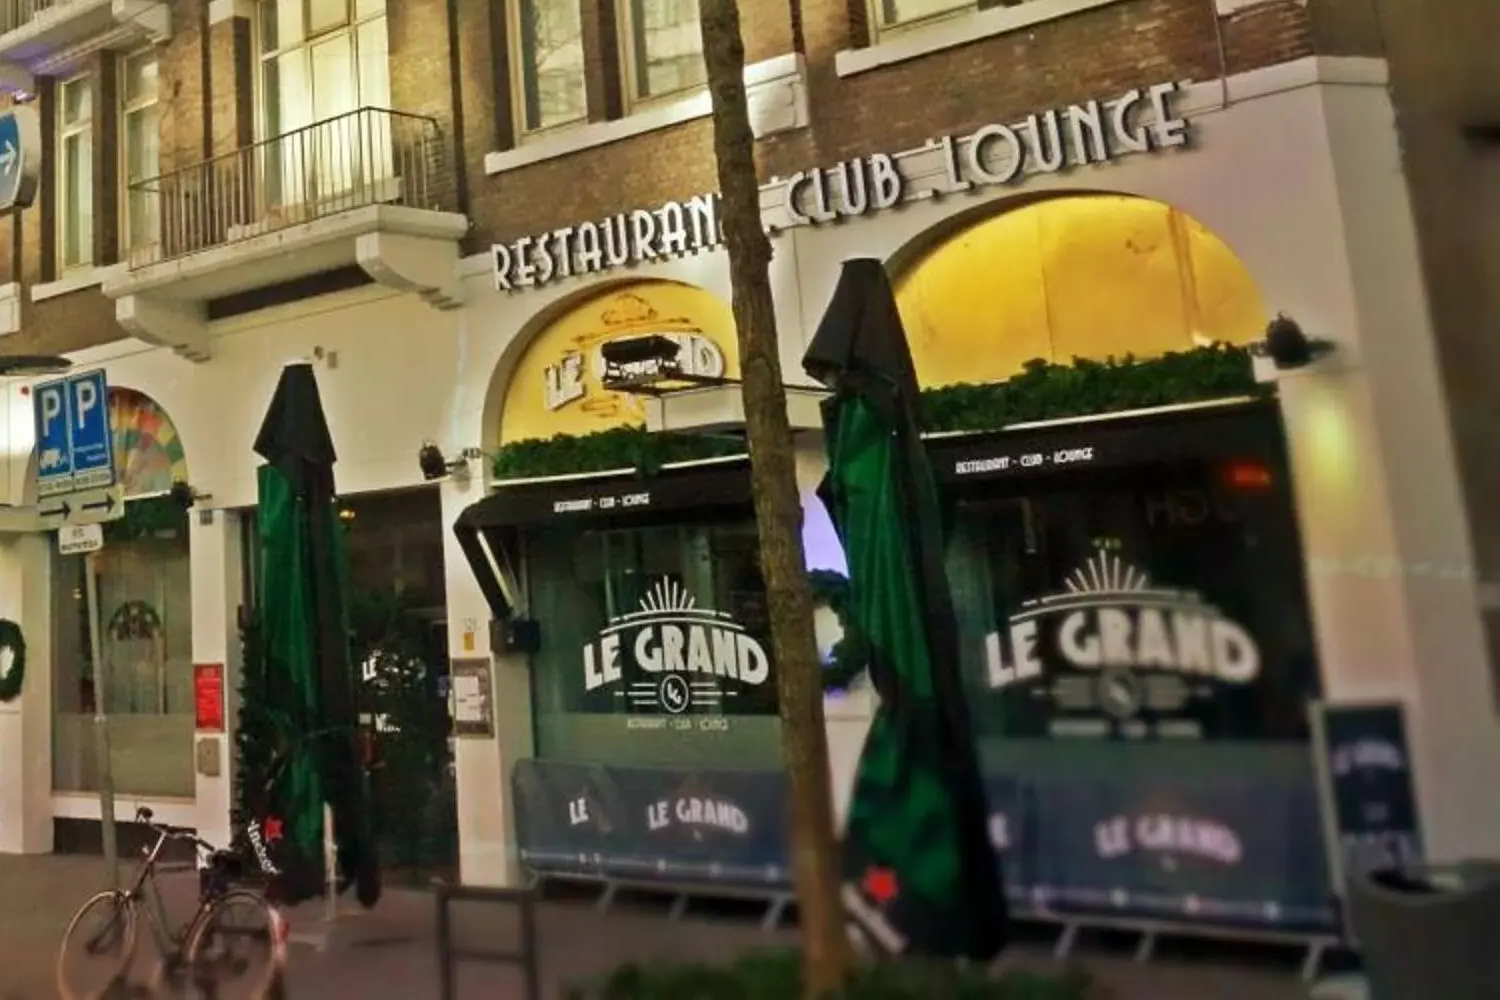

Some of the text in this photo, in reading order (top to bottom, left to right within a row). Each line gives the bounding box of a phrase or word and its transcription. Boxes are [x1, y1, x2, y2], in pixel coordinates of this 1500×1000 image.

[490, 82, 1187, 290] RESTAURAN CLUB LOUNGE
[42, 381, 96, 437] P P
[545, 352, 584, 410] LE
[583, 626, 770, 691] LE GRAND
[985, 610, 1261, 689] LE GRAND
[569, 797, 589, 825] LE
[648, 797, 749, 834] LE GRAND
